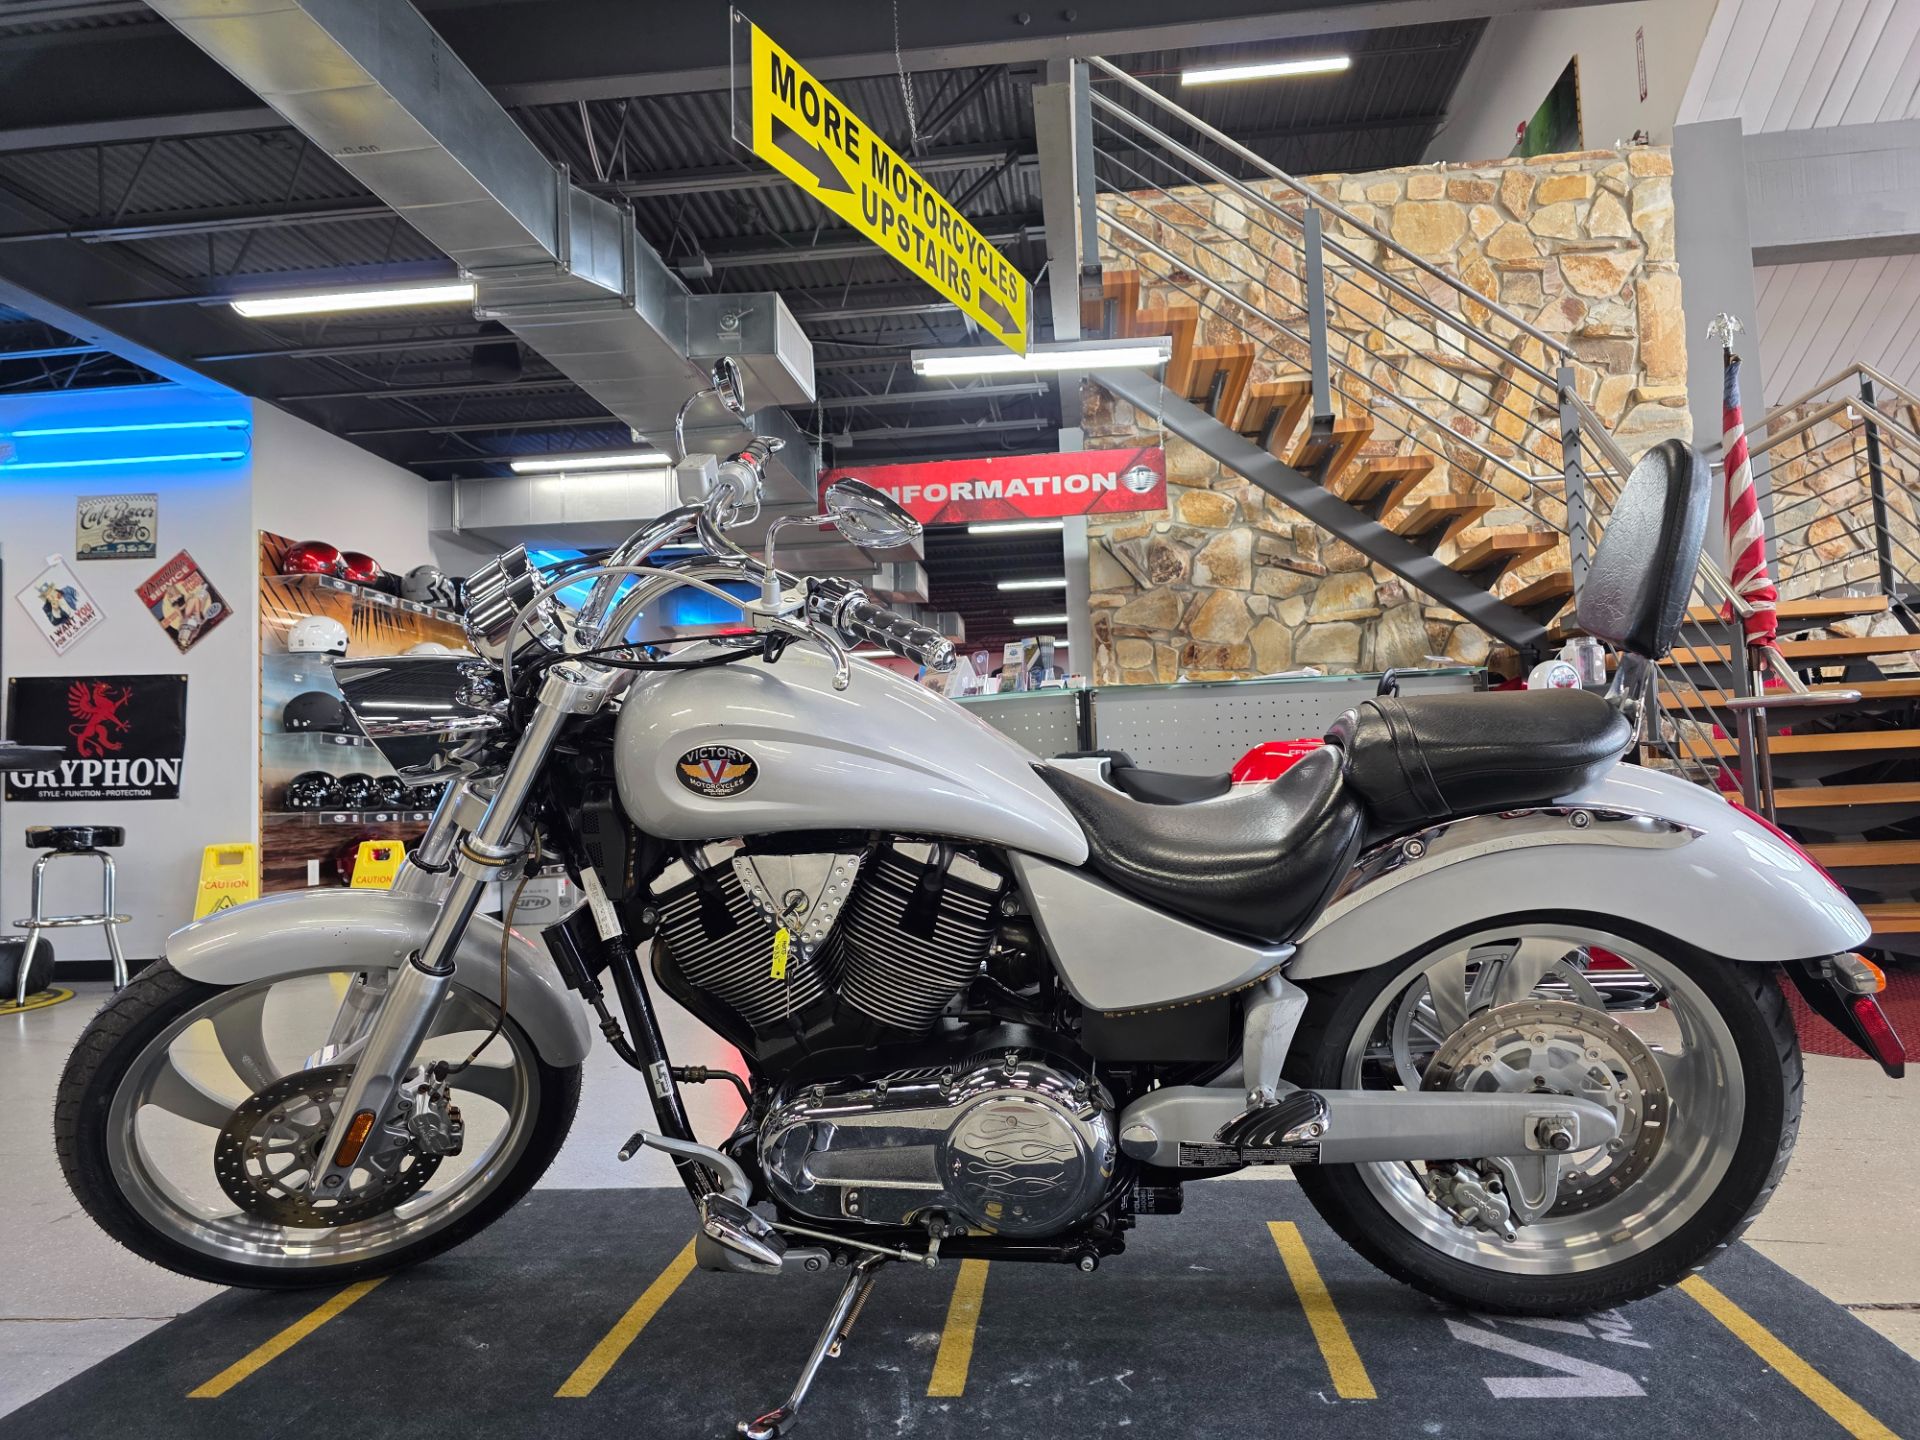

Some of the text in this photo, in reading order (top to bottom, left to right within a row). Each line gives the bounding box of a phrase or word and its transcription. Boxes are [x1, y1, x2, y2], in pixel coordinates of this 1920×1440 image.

[771, 50, 1018, 304] MORE MOTORCYCLES
[861, 181, 972, 302] UPSTAIRS
[149, 565, 190, 601] SERVICE
[54, 615, 77, 638] WANT
[74, 601, 94, 619] YOU
[54, 636, 67, 648] FOR
[79, 610, 97, 627] ARMY
[686, 747, 746, 762] VICTORY
[38, 790, 61, 798] STYLE
[106, 789, 152, 797] PROTECTION
[689, 778, 745, 789] MOTORCYCLES
[204, 880, 249, 890] CAUTION
[355, 875, 393, 885] CAUTION
